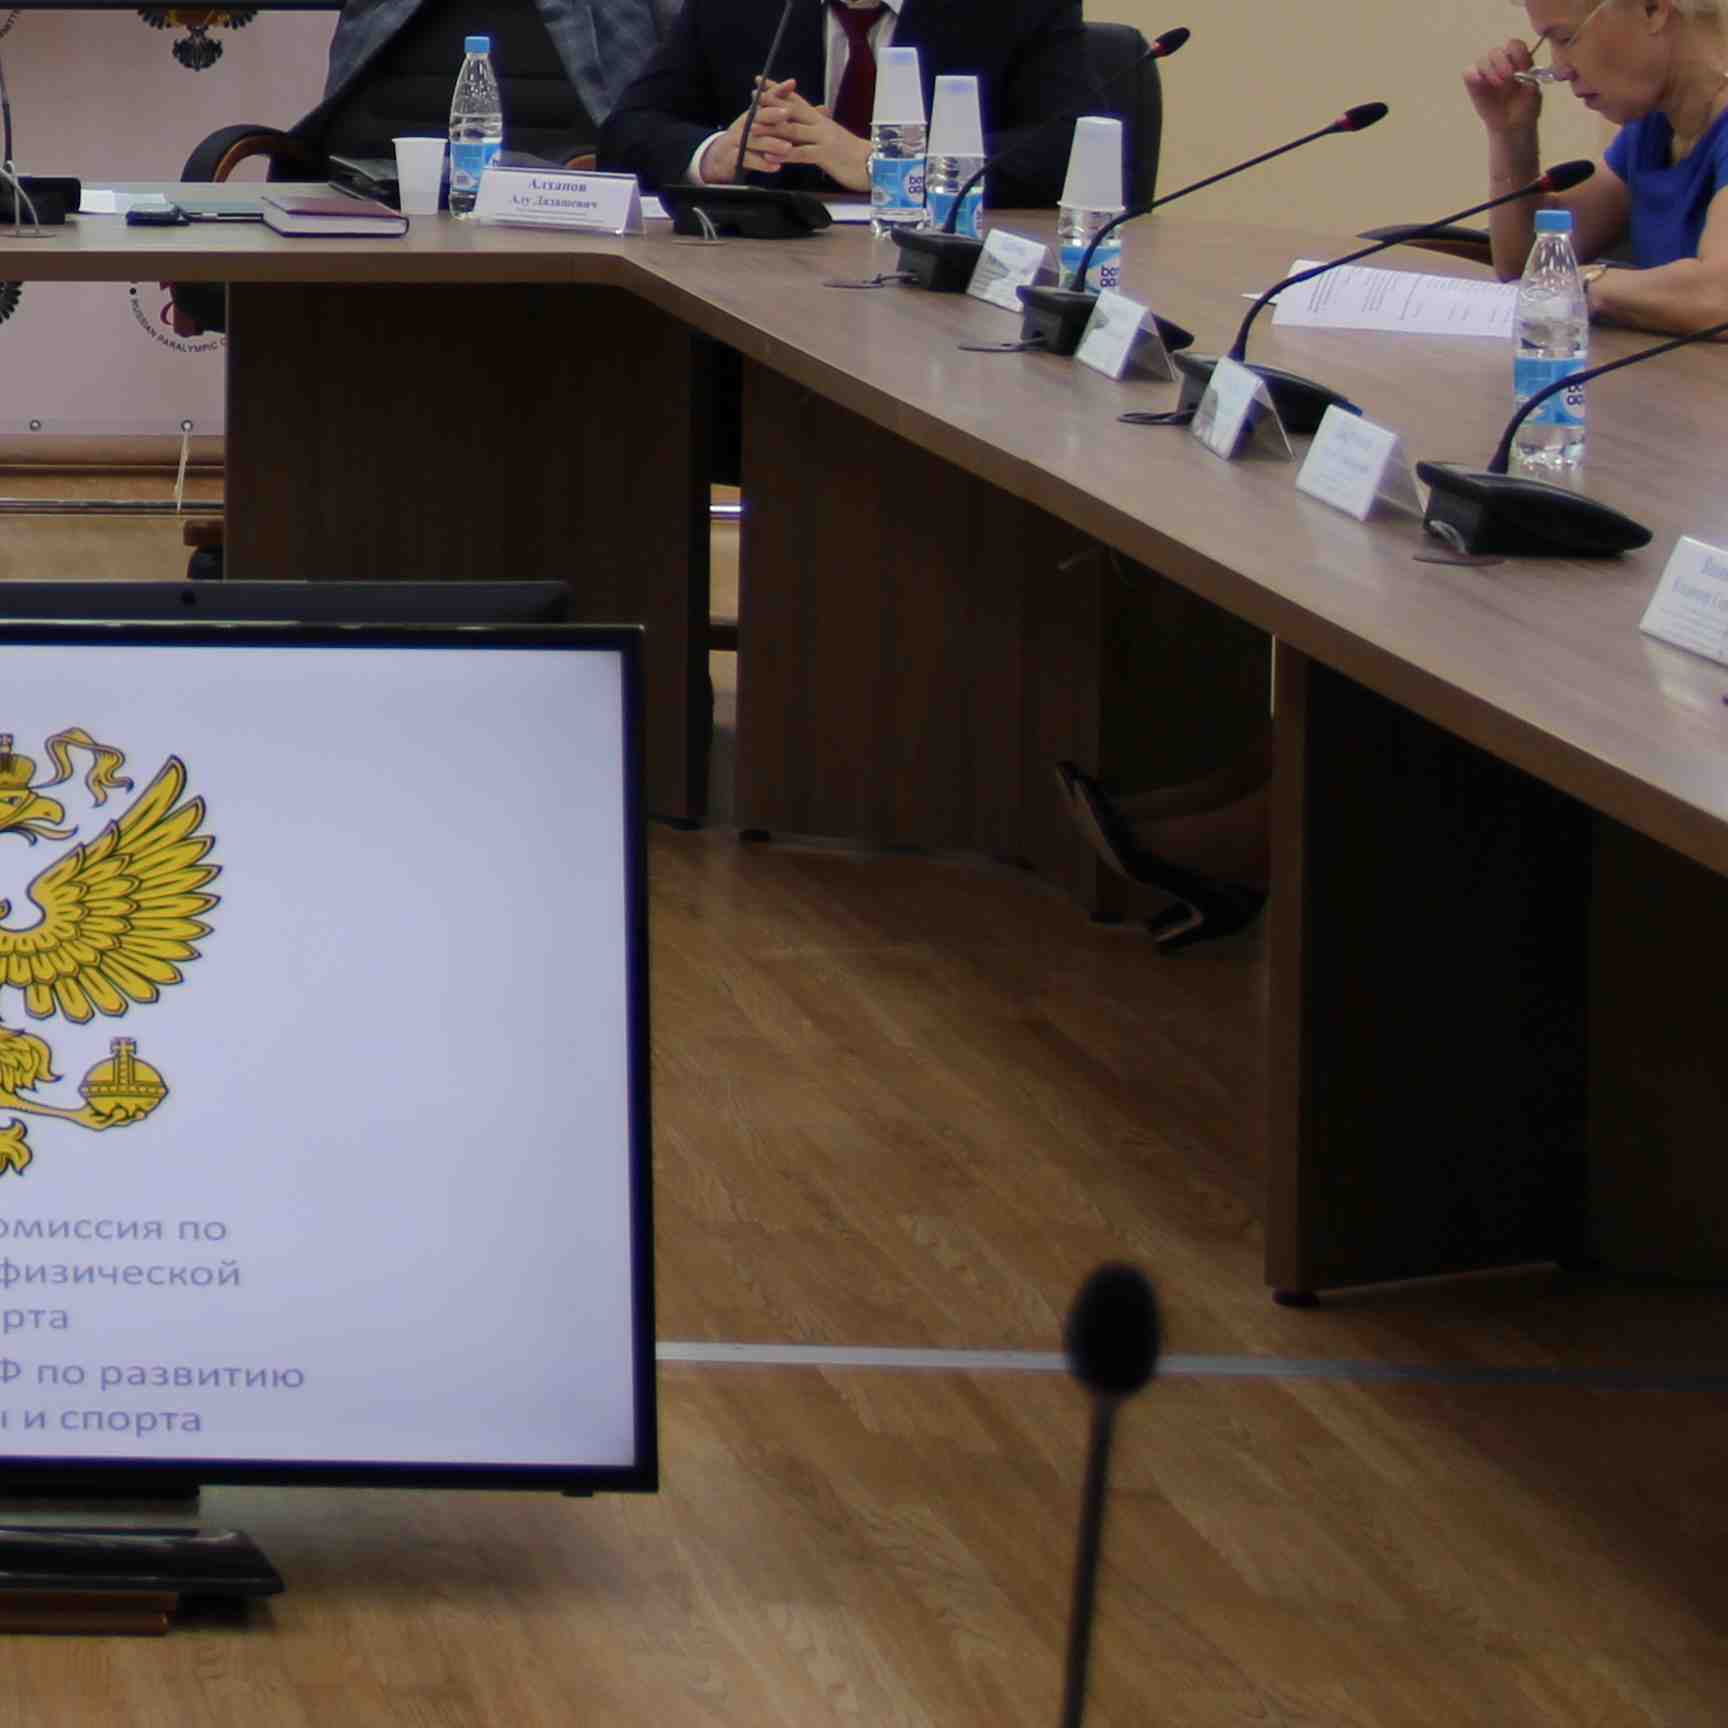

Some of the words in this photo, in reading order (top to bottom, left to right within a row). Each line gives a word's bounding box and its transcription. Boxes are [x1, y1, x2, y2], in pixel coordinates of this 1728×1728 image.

[528, 177, 587, 192] Алханов
[156, 334, 218, 353] PARALYMPIC
[179, 1220, 228, 1242] по
[37, 1363, 86, 1386] по
[100, 1363, 305, 1392] развитию
[24, 1409, 47, 1430] и
[59, 1409, 203, 1437] спорта
